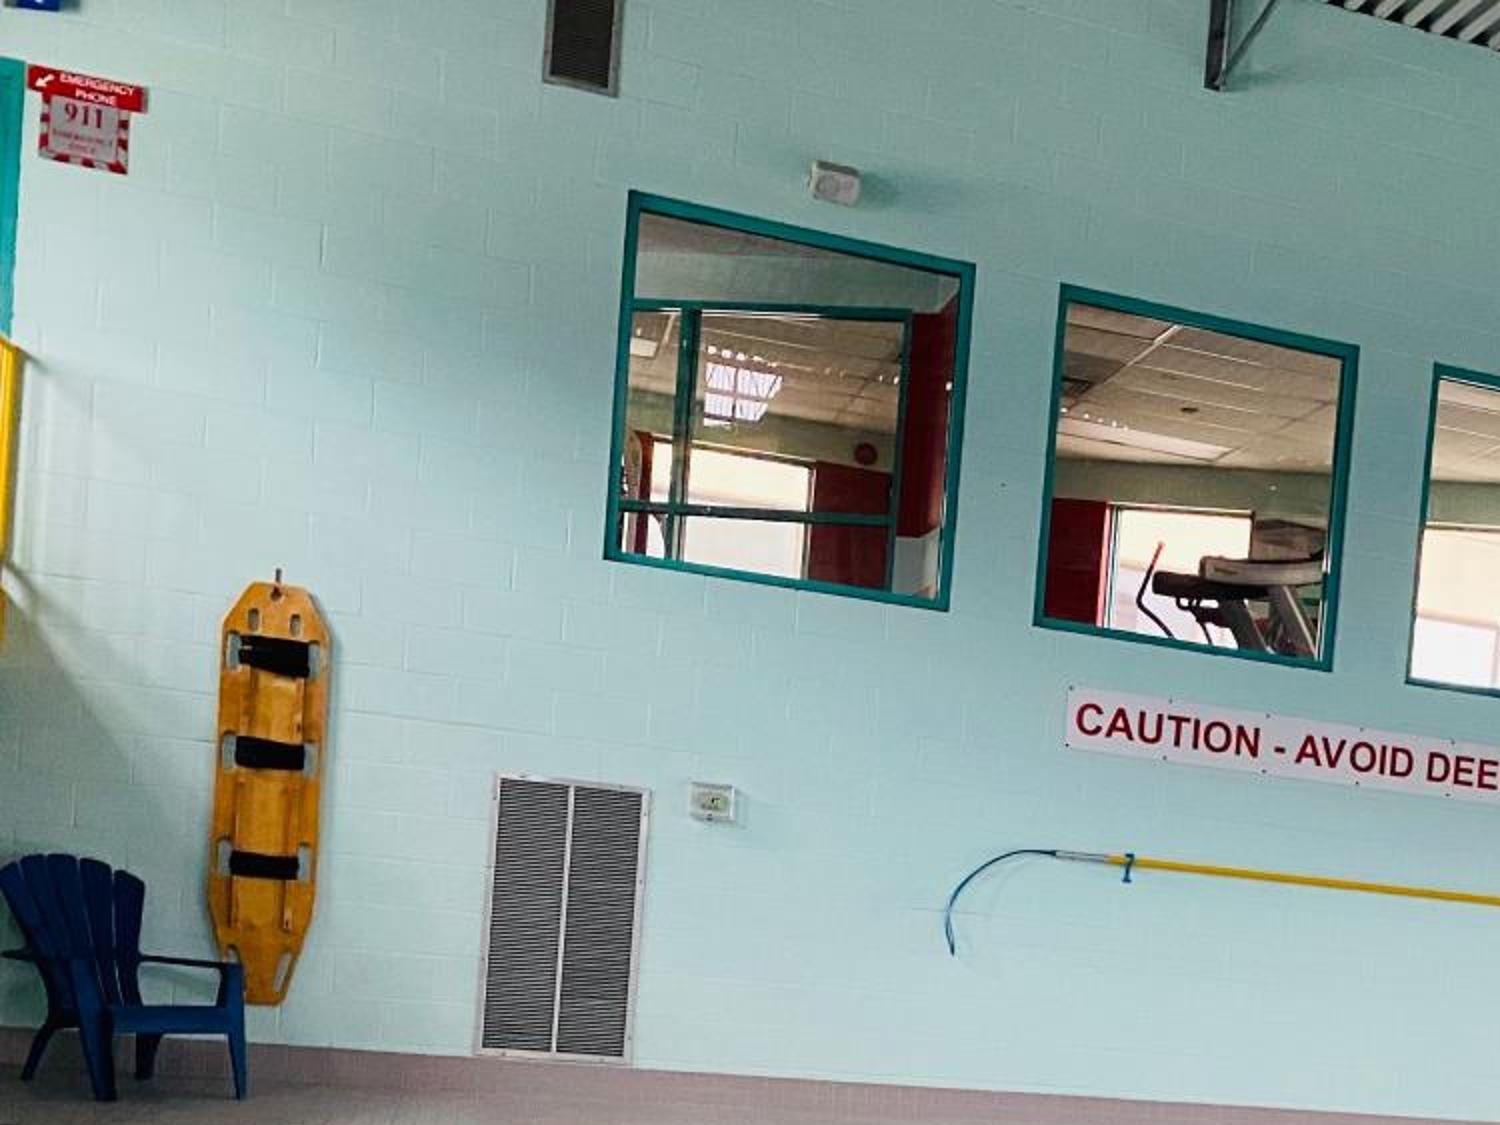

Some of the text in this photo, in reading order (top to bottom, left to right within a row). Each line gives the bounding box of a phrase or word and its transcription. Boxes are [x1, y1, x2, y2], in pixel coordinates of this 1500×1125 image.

[60, 73, 134, 96] EMERGENCY
[75, 87, 117, 106] PHONE
[65, 102, 102, 129] 911
[1075, 702, 1261, 758] CAUTION
[1295, 735, 1414, 777] AVOID
